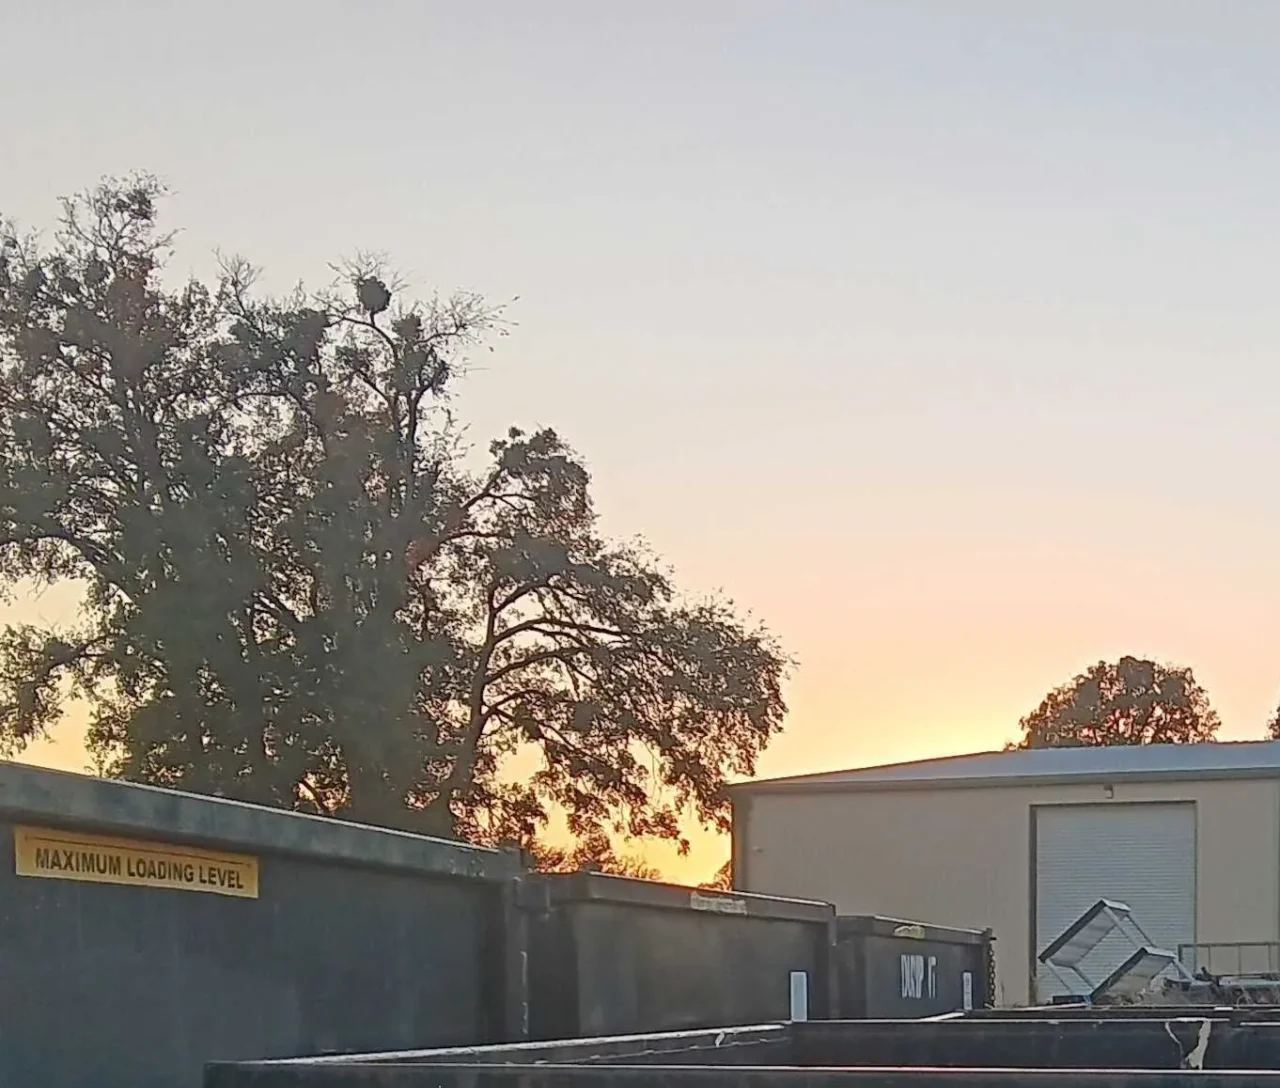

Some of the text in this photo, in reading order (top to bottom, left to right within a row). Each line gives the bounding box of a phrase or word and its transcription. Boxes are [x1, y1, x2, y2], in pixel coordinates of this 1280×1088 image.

[35, 847, 245, 890] MAXIMUM LOADING LEVEL
